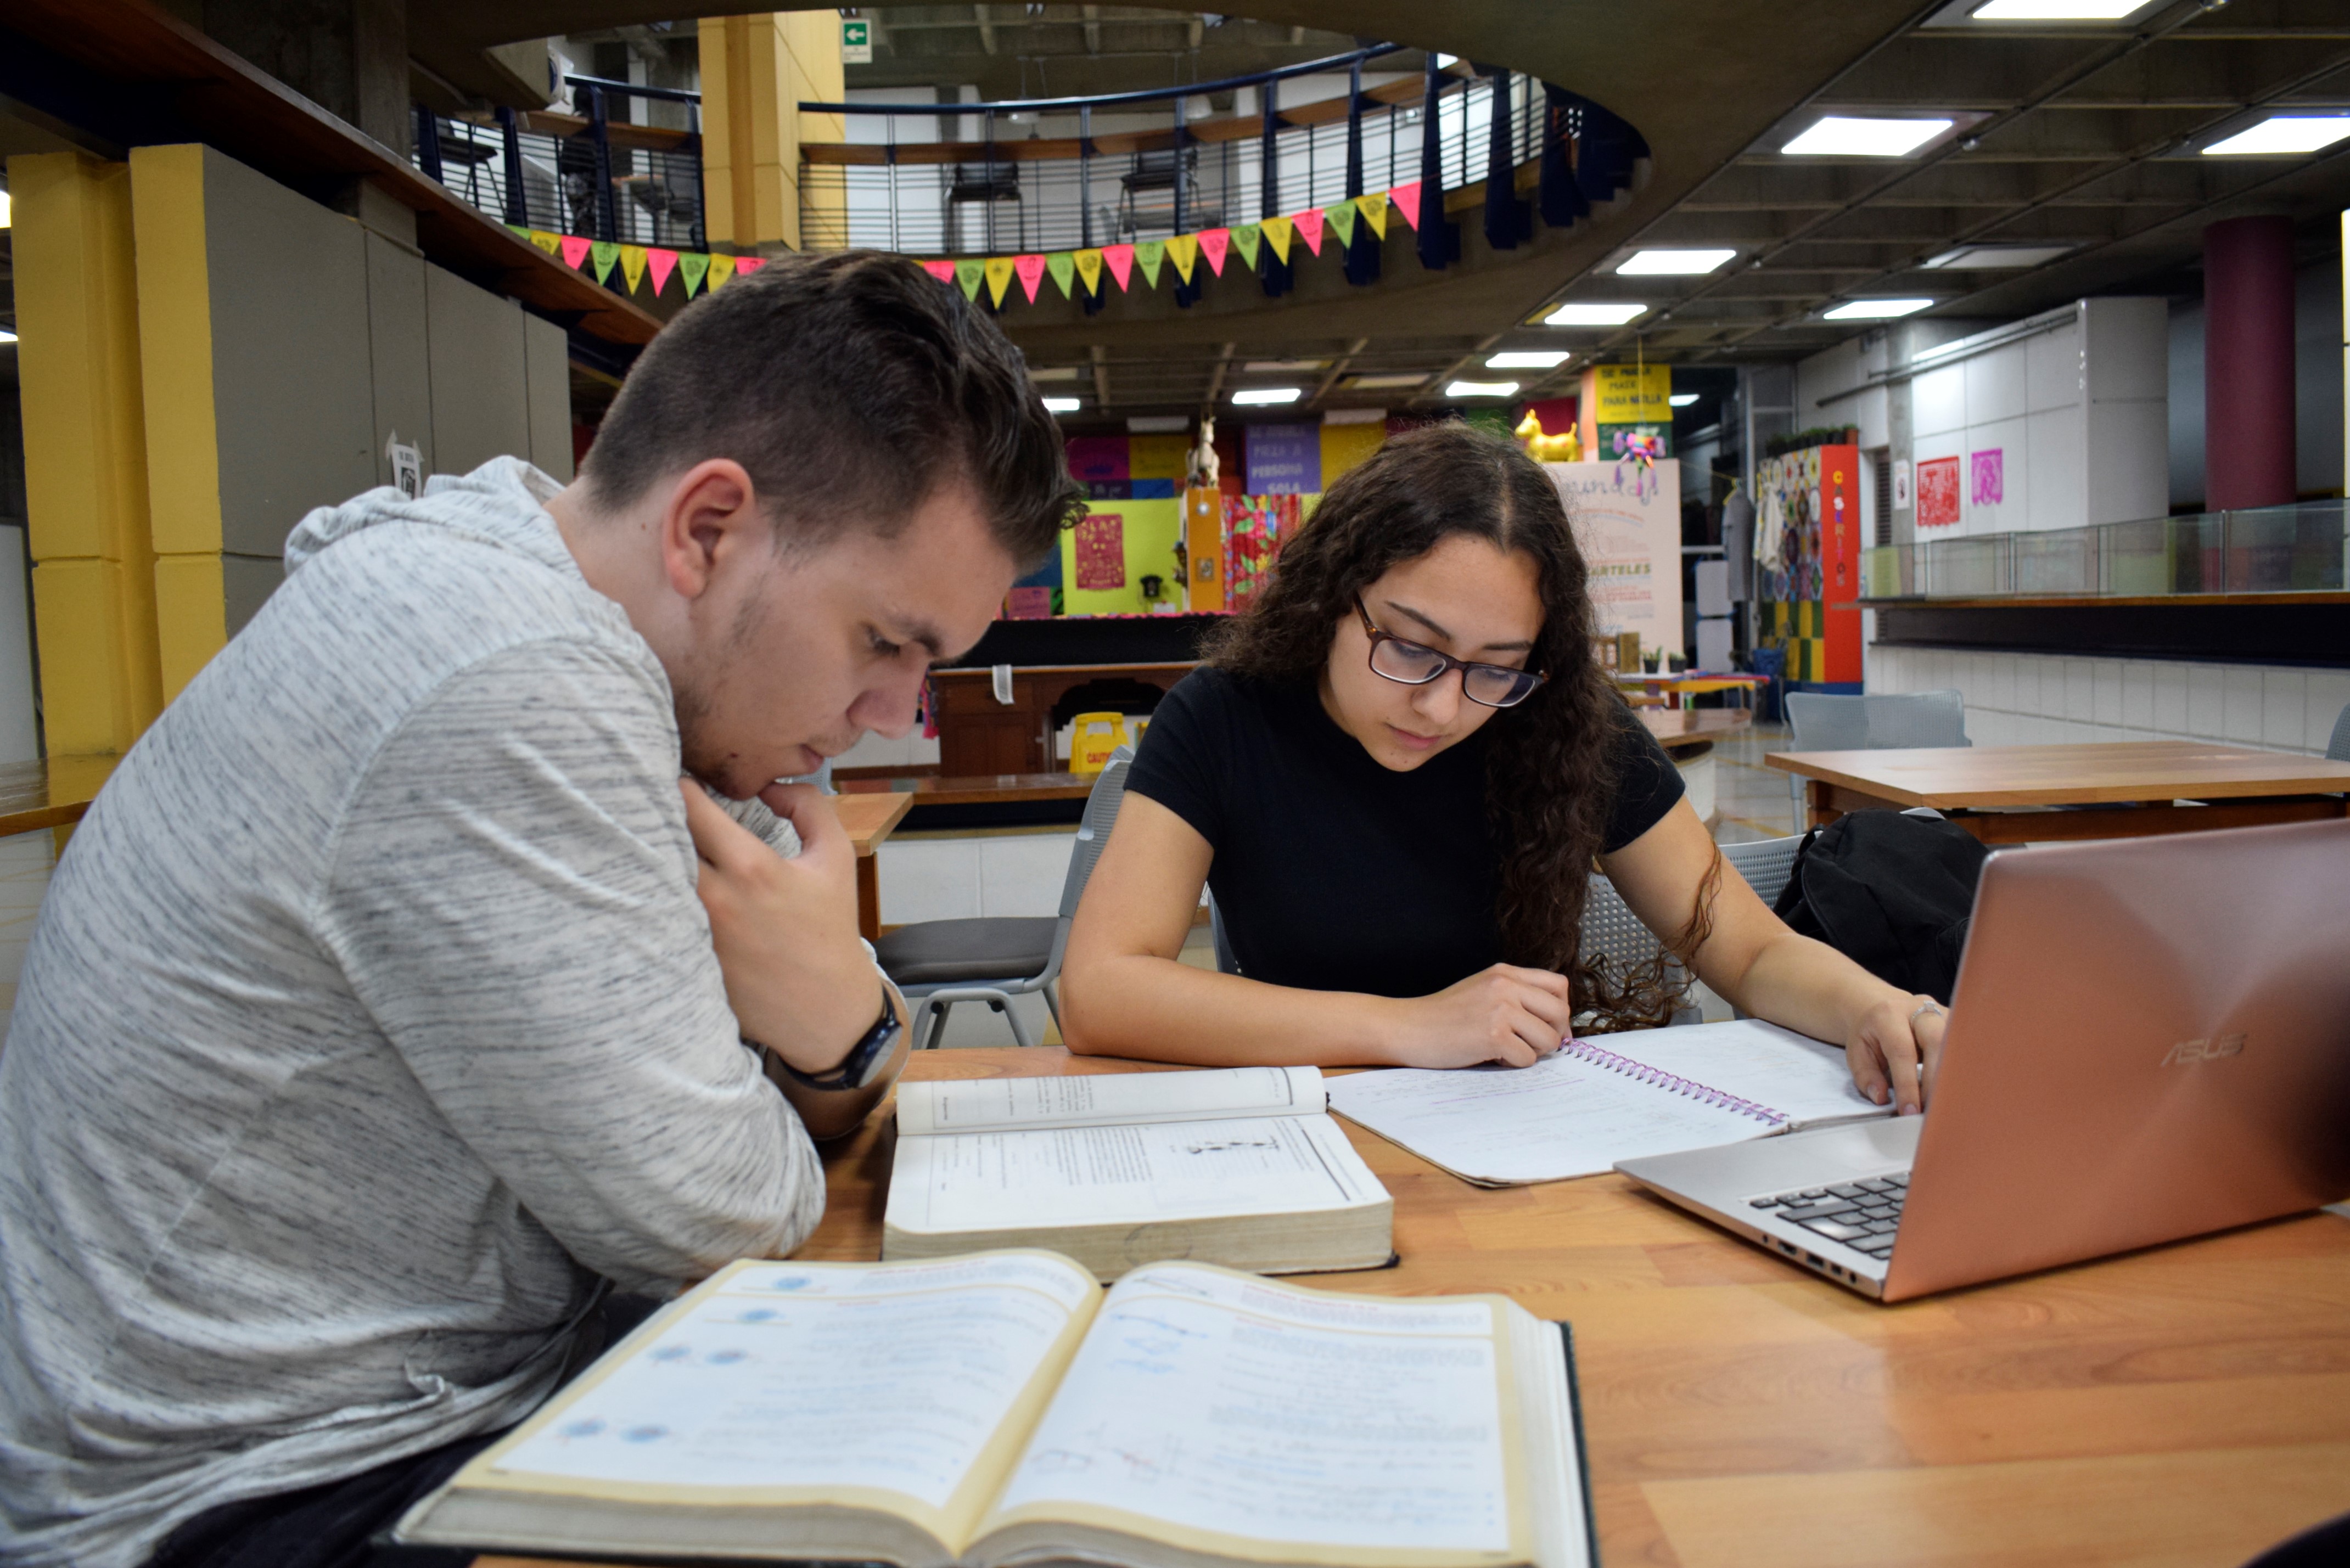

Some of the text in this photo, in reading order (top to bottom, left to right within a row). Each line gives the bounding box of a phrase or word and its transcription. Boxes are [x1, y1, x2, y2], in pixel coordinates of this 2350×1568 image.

[1832, 470, 1846, 587] CASERITOS
[1589, 563, 1651, 576] ARTELES
[2161, 1032, 2247, 1067] ASUS
